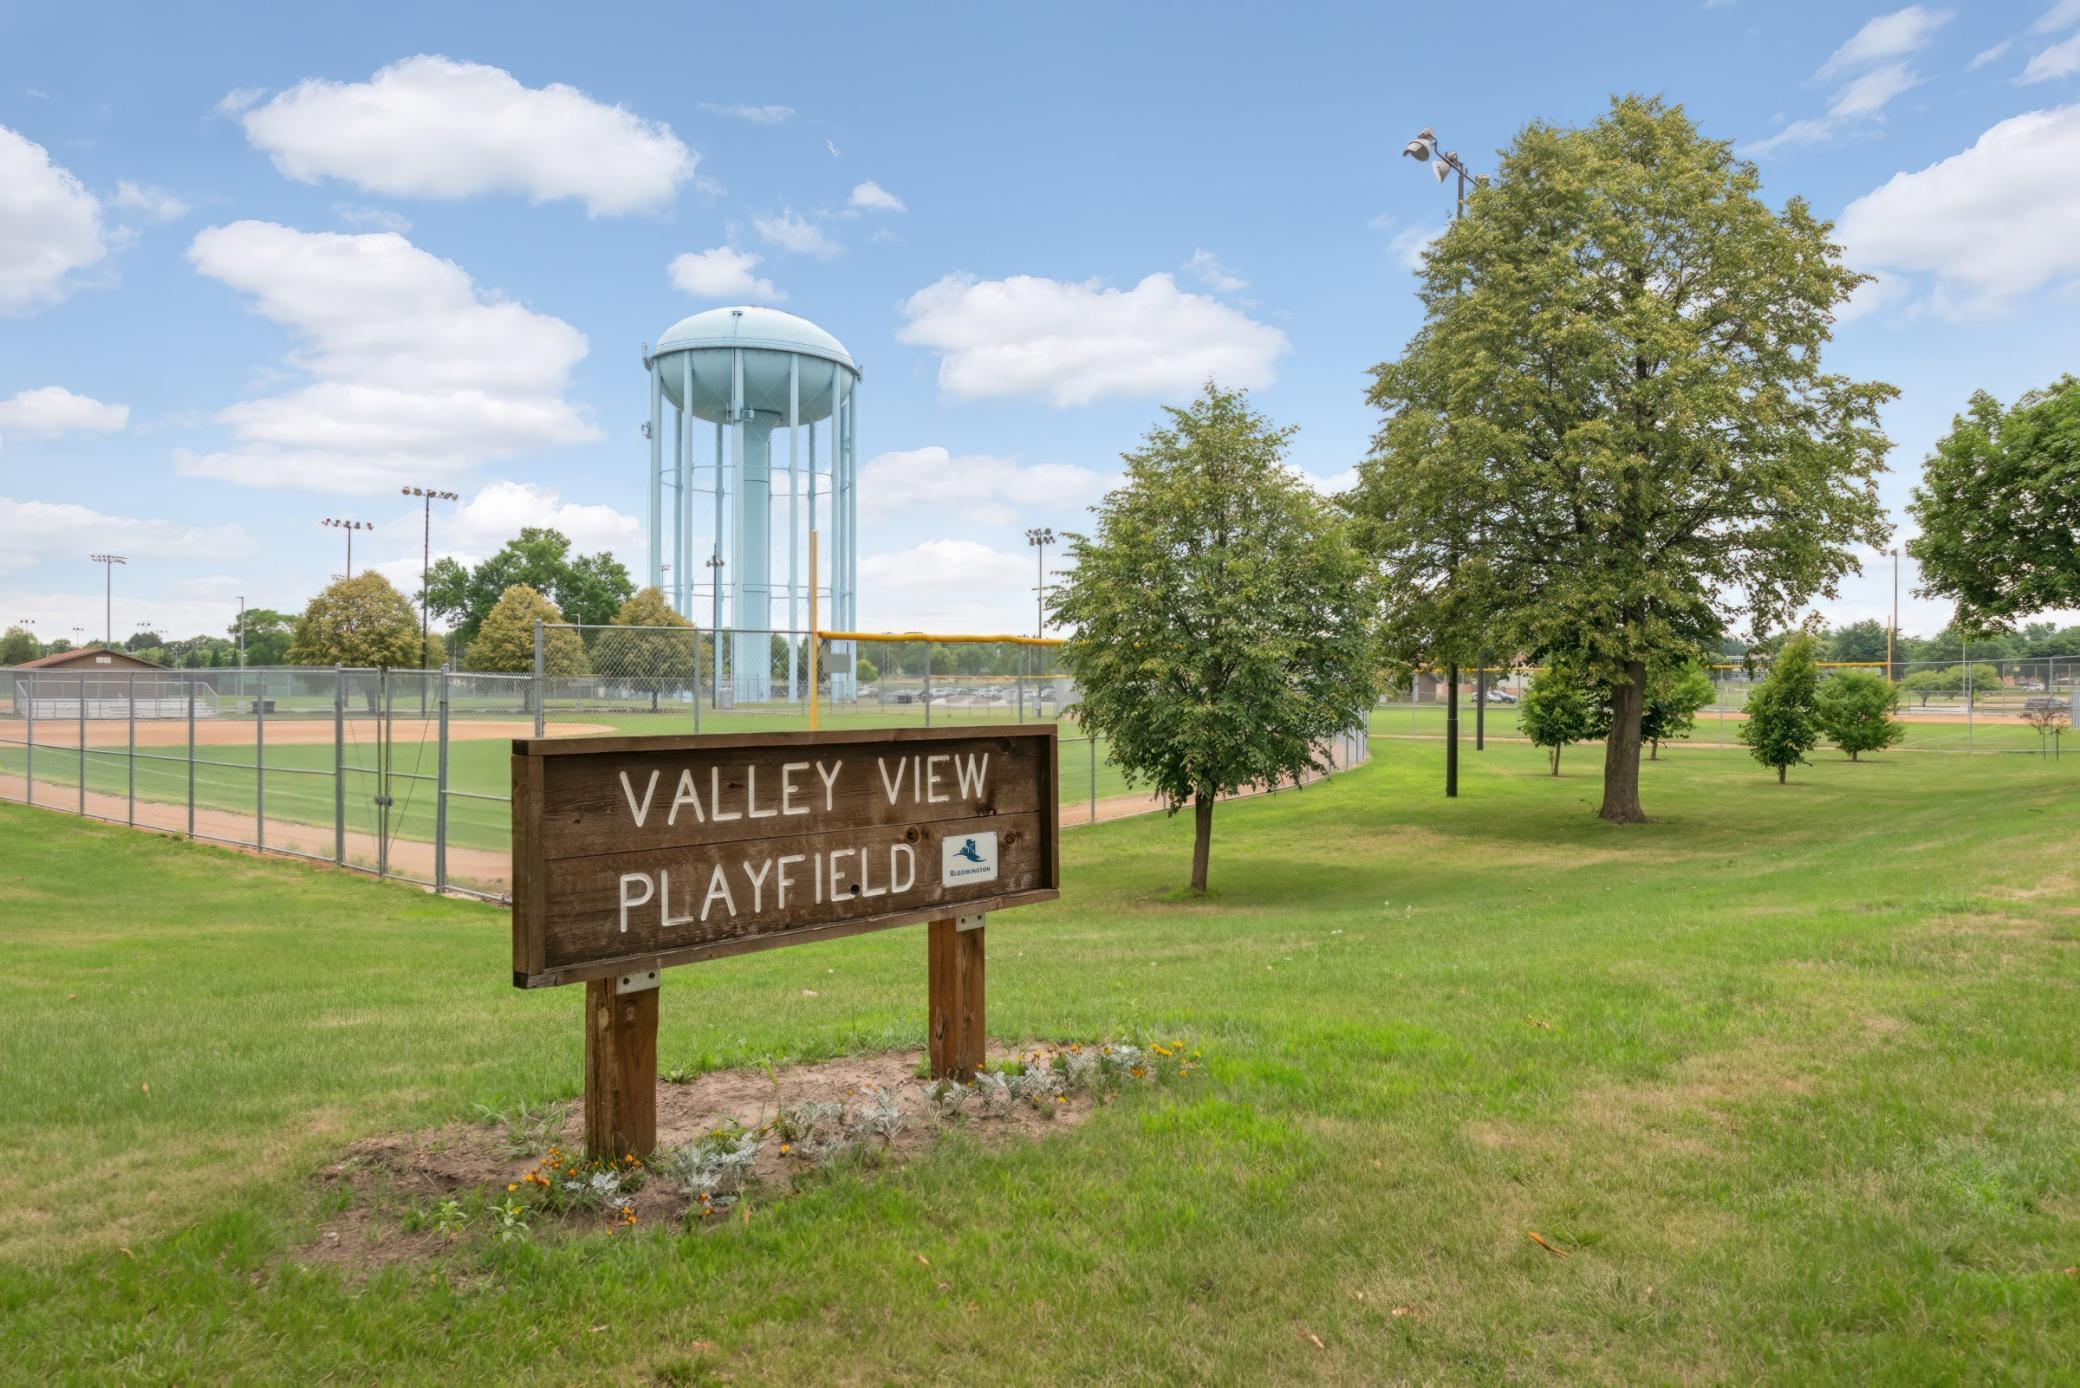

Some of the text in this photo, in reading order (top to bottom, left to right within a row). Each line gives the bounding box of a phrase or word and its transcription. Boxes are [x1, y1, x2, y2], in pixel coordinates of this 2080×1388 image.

[618, 752, 990, 828] VALLEY VIEW
[618, 843, 917, 934] PLAYFIELD
